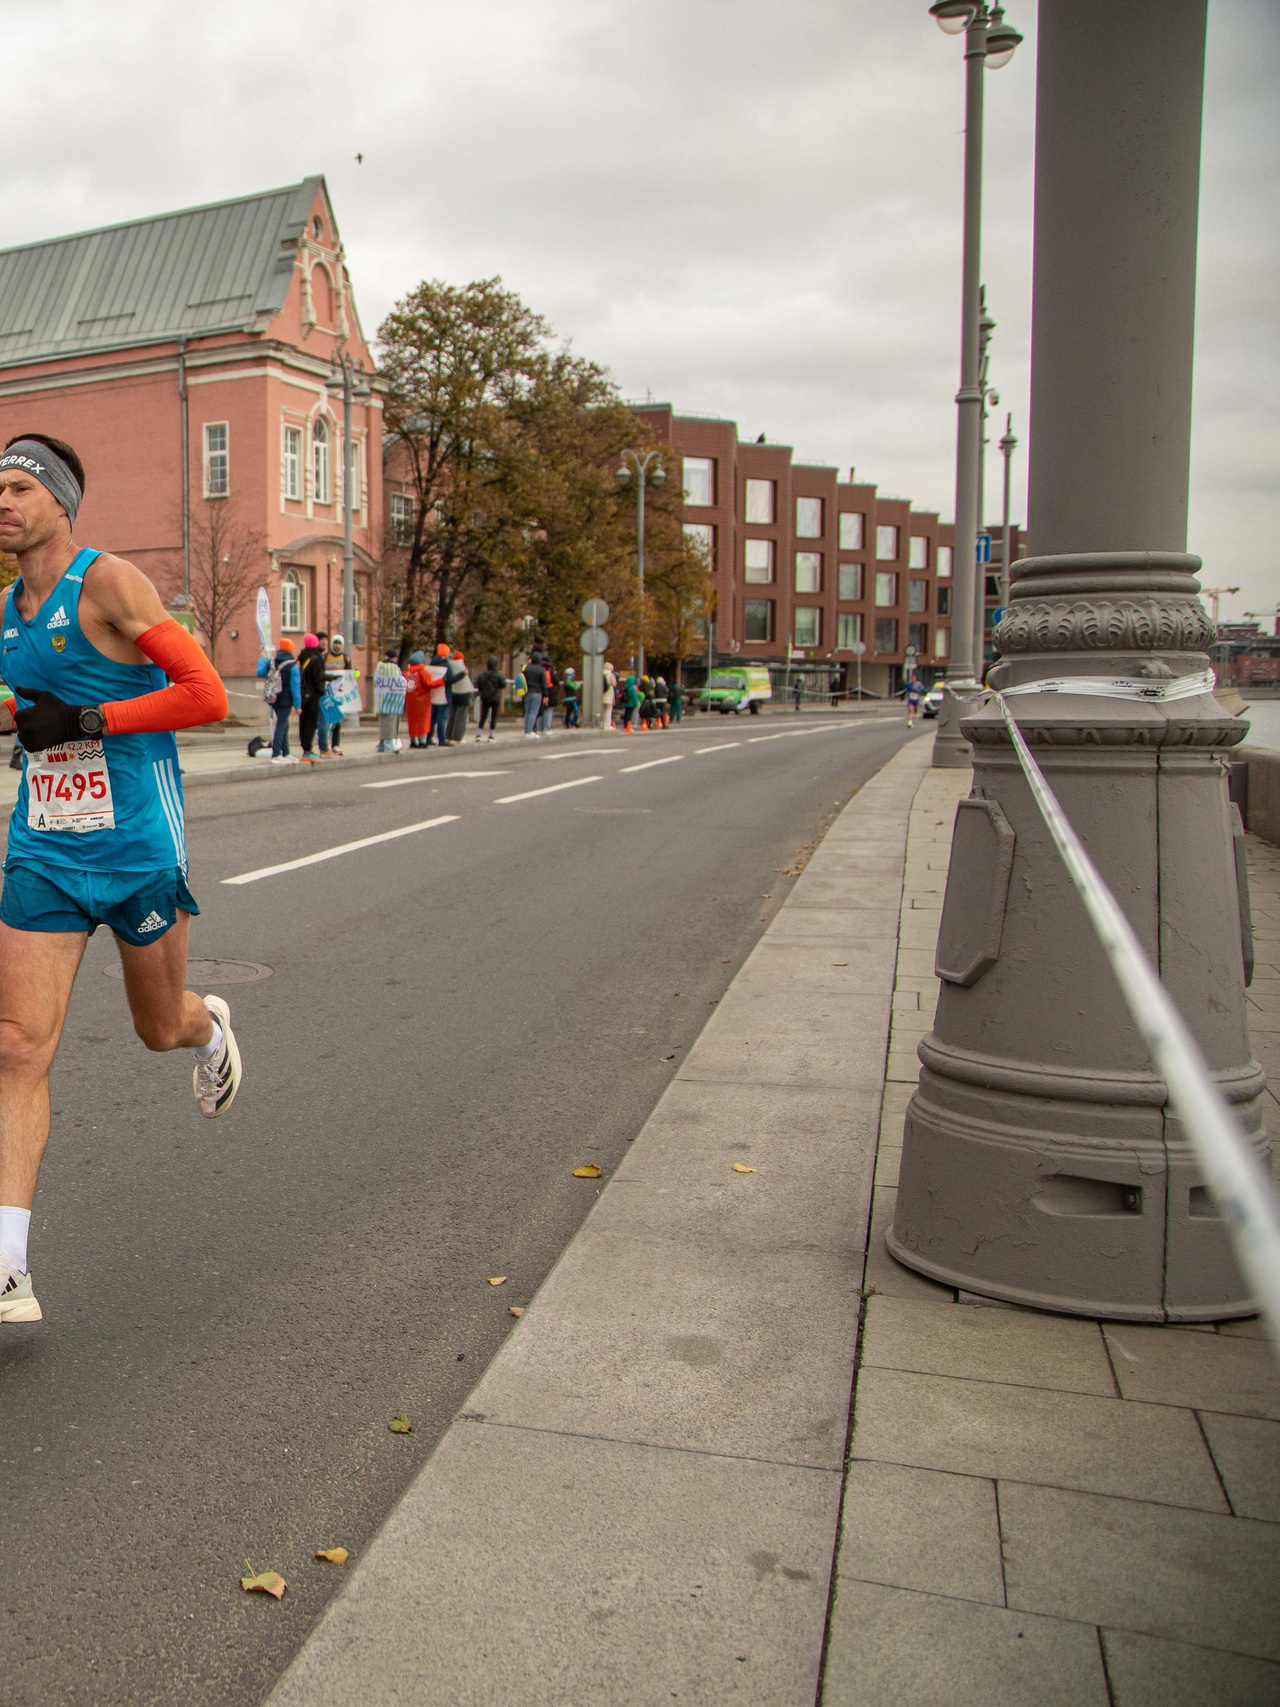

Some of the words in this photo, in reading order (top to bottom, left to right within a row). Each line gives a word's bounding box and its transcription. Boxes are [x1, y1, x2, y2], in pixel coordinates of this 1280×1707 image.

[47, 618, 70, 629] adidas
[67, 742, 83, 751] 42,2
[31, 771, 107, 802] 17495
[137, 920, 168, 933] adidas
